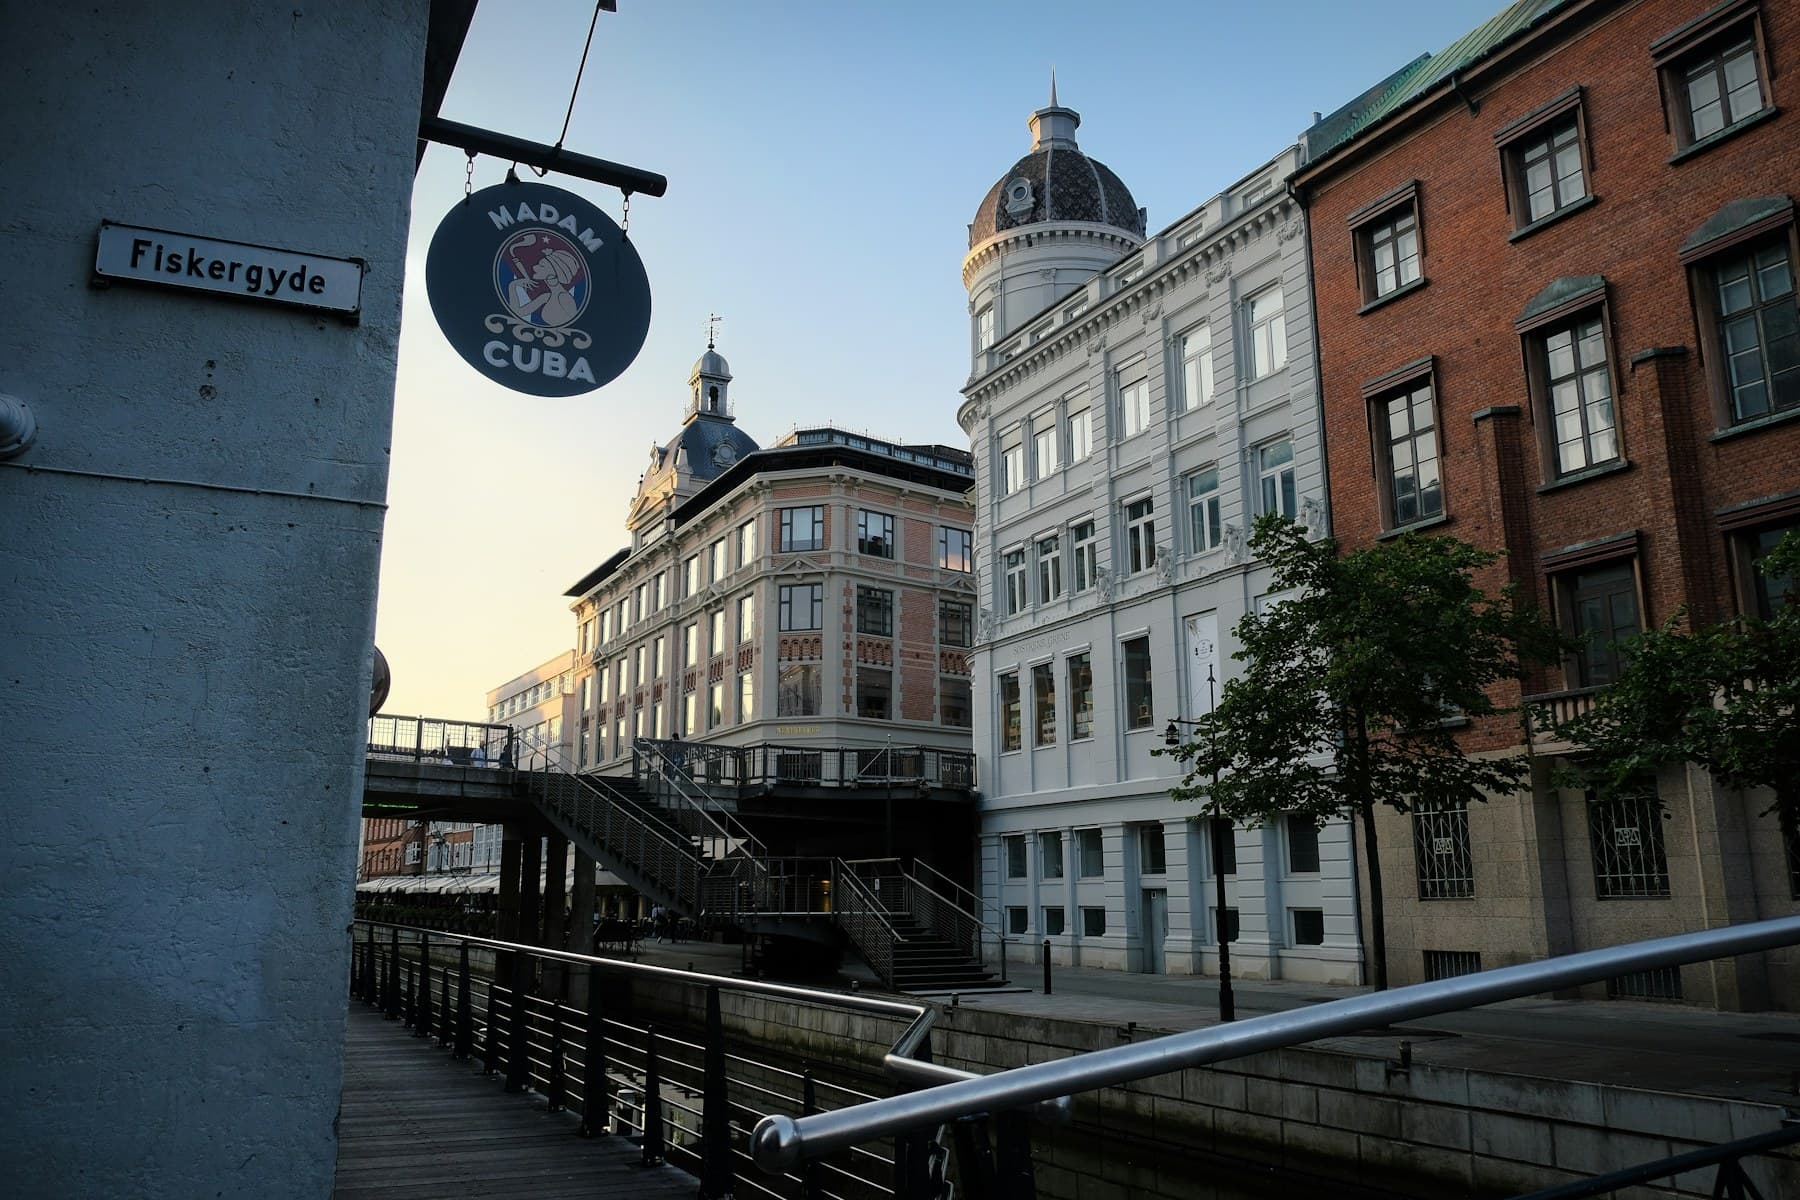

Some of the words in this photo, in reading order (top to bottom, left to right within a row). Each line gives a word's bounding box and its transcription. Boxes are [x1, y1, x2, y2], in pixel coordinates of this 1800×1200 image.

[487, 201, 604, 254] MADAM
[130, 238, 326, 297] Fiskergyde
[483, 340, 597, 385] CUBA
